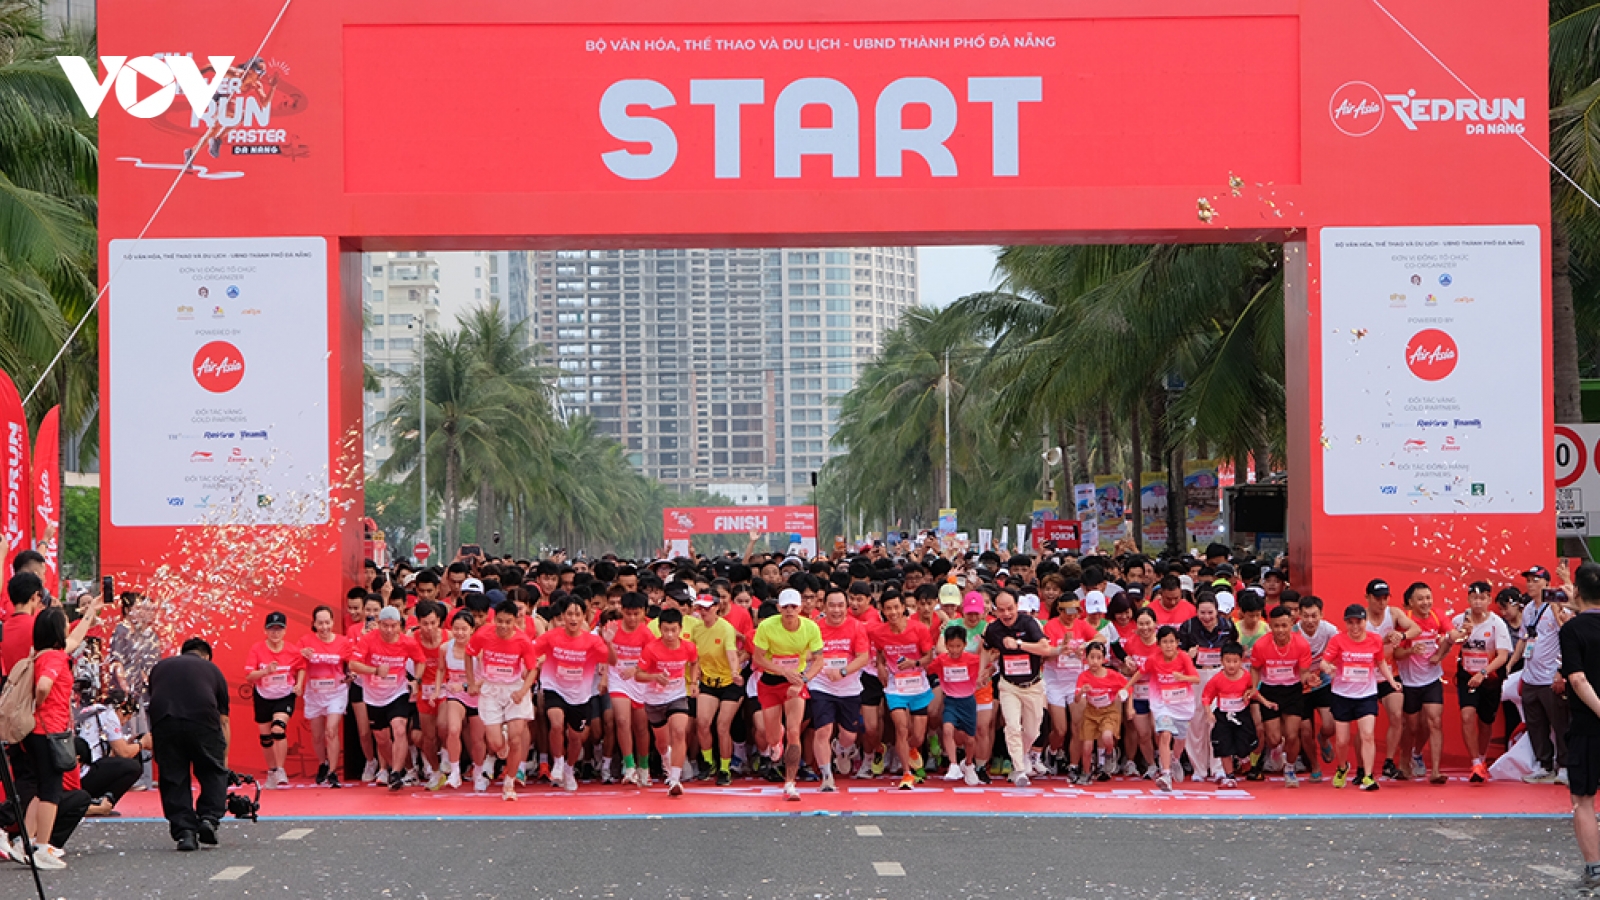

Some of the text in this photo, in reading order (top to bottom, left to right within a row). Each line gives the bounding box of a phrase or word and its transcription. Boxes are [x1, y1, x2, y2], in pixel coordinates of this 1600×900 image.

[585, 37, 607, 55] BỘ
[610, 37, 641, 52] VĂN
[644, 36, 681, 53] HÓA,
[714, 38, 757, 51] THAO
[759, 36, 780, 51] VÀ
[782, 38, 805, 51] DU
[807, 37, 841, 53] LỊCH
[852, 37, 897, 51] UBND
[898, 34, 951, 50] THÀNH
[953, 33, 987, 49] PHỐ
[988, 34, 1011, 49] ĐÀ
[1383, 88, 1526, 130] REDRUN
[599, 76, 1043, 180] START
[1465, 123, 1526, 135] DA NANG
[227, 128, 287, 144] FASTER
[234, 146, 279, 154] DA NANG
[1407, 316, 1443, 324] POWERED
[195, 328, 230, 337] POWERED
[1404, 404, 1460, 412] GOLD PARTNERS
[714, 515, 768, 531] FINISH
